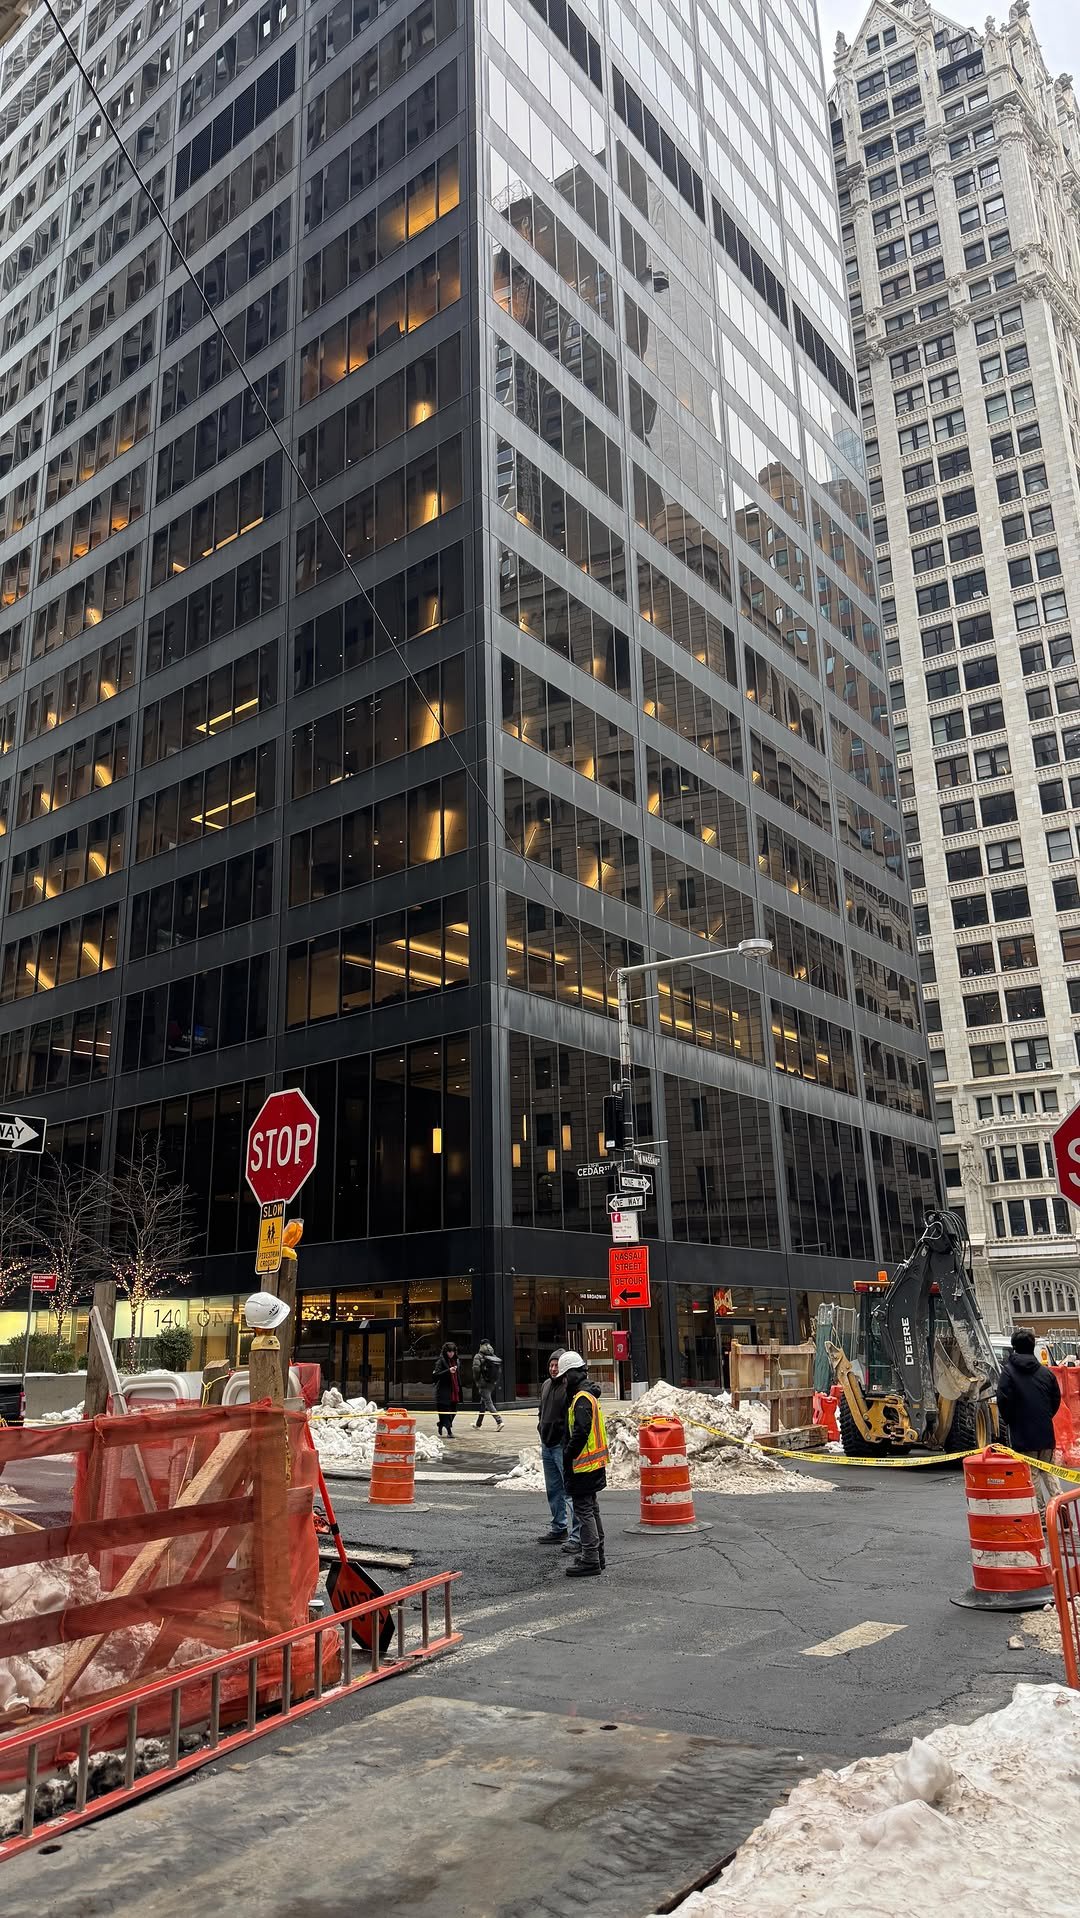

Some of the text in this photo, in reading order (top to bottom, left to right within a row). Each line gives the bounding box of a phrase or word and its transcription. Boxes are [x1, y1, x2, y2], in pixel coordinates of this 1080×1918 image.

[250, 1123, 312, 1172] STOP
[577, 1166, 605, 1176] CEDAR
[624, 1178, 647, 1188] ONE WAY
[612, 1197, 640, 1207] ONE WAY
[263, 1203, 283, 1217] SLOW
[615, 1262, 642, 1271] STREET
[615, 1277, 643, 1286] DETOUR
[153, 1308, 181, 1327] 140
[901, 1317, 914, 1366] DEERE
